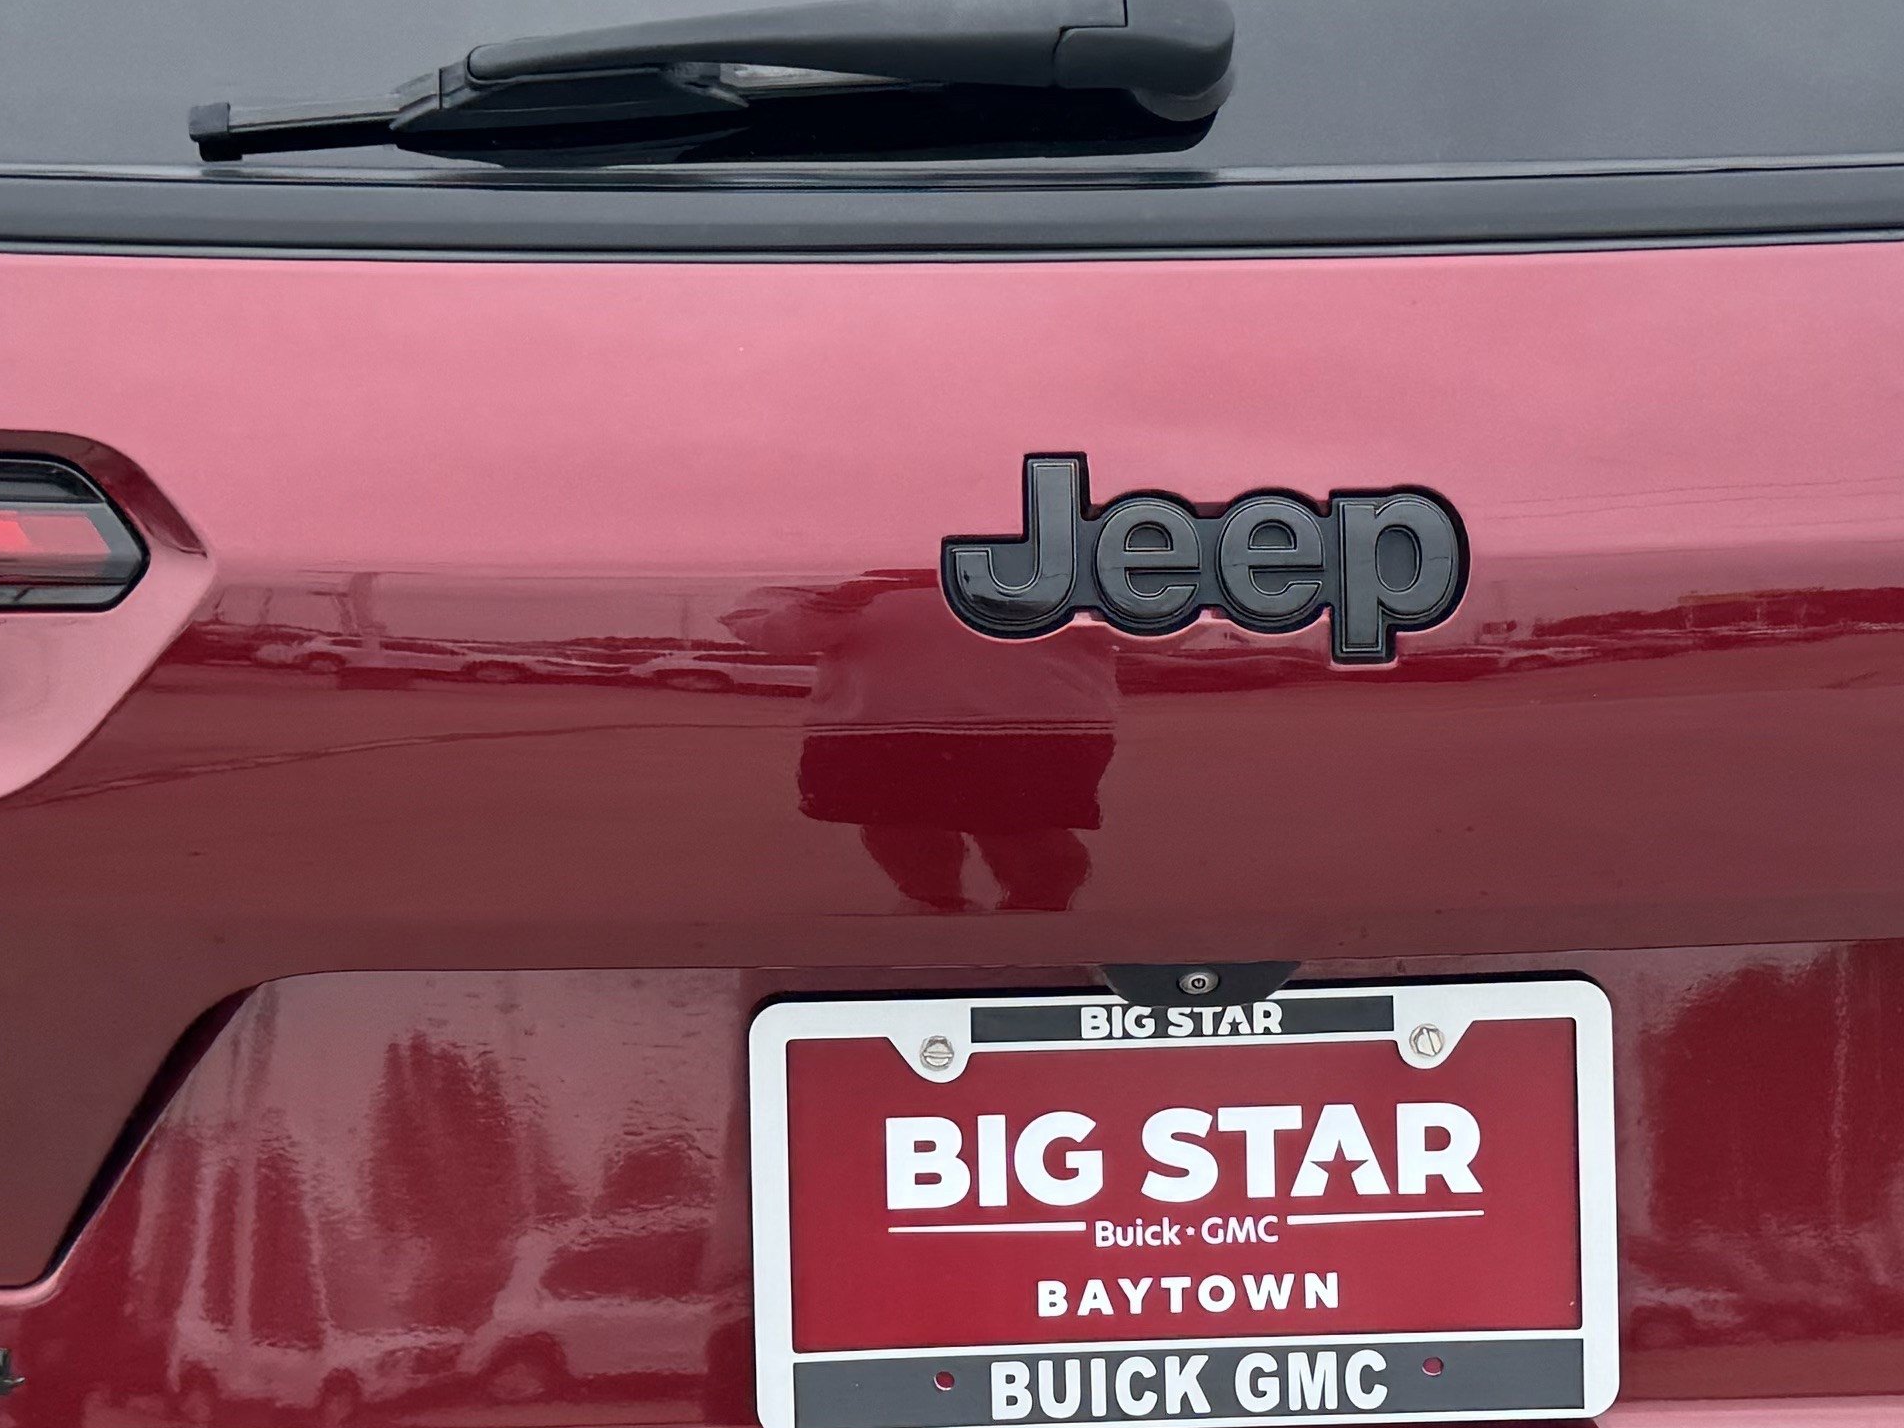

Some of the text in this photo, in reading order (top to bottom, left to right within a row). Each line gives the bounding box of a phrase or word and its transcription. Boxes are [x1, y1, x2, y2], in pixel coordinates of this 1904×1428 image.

[941, 451, 1471, 664] Jeep
[1080, 1000, 1284, 1040] BIG STAR
[884, 1102, 1485, 1212] BIG STAR
[1094, 1215, 1280, 1249] Buick GMC
[1036, 1271, 1340, 1319] BAYTOWN
[990, 1349, 1389, 1421] BUICK GMC
